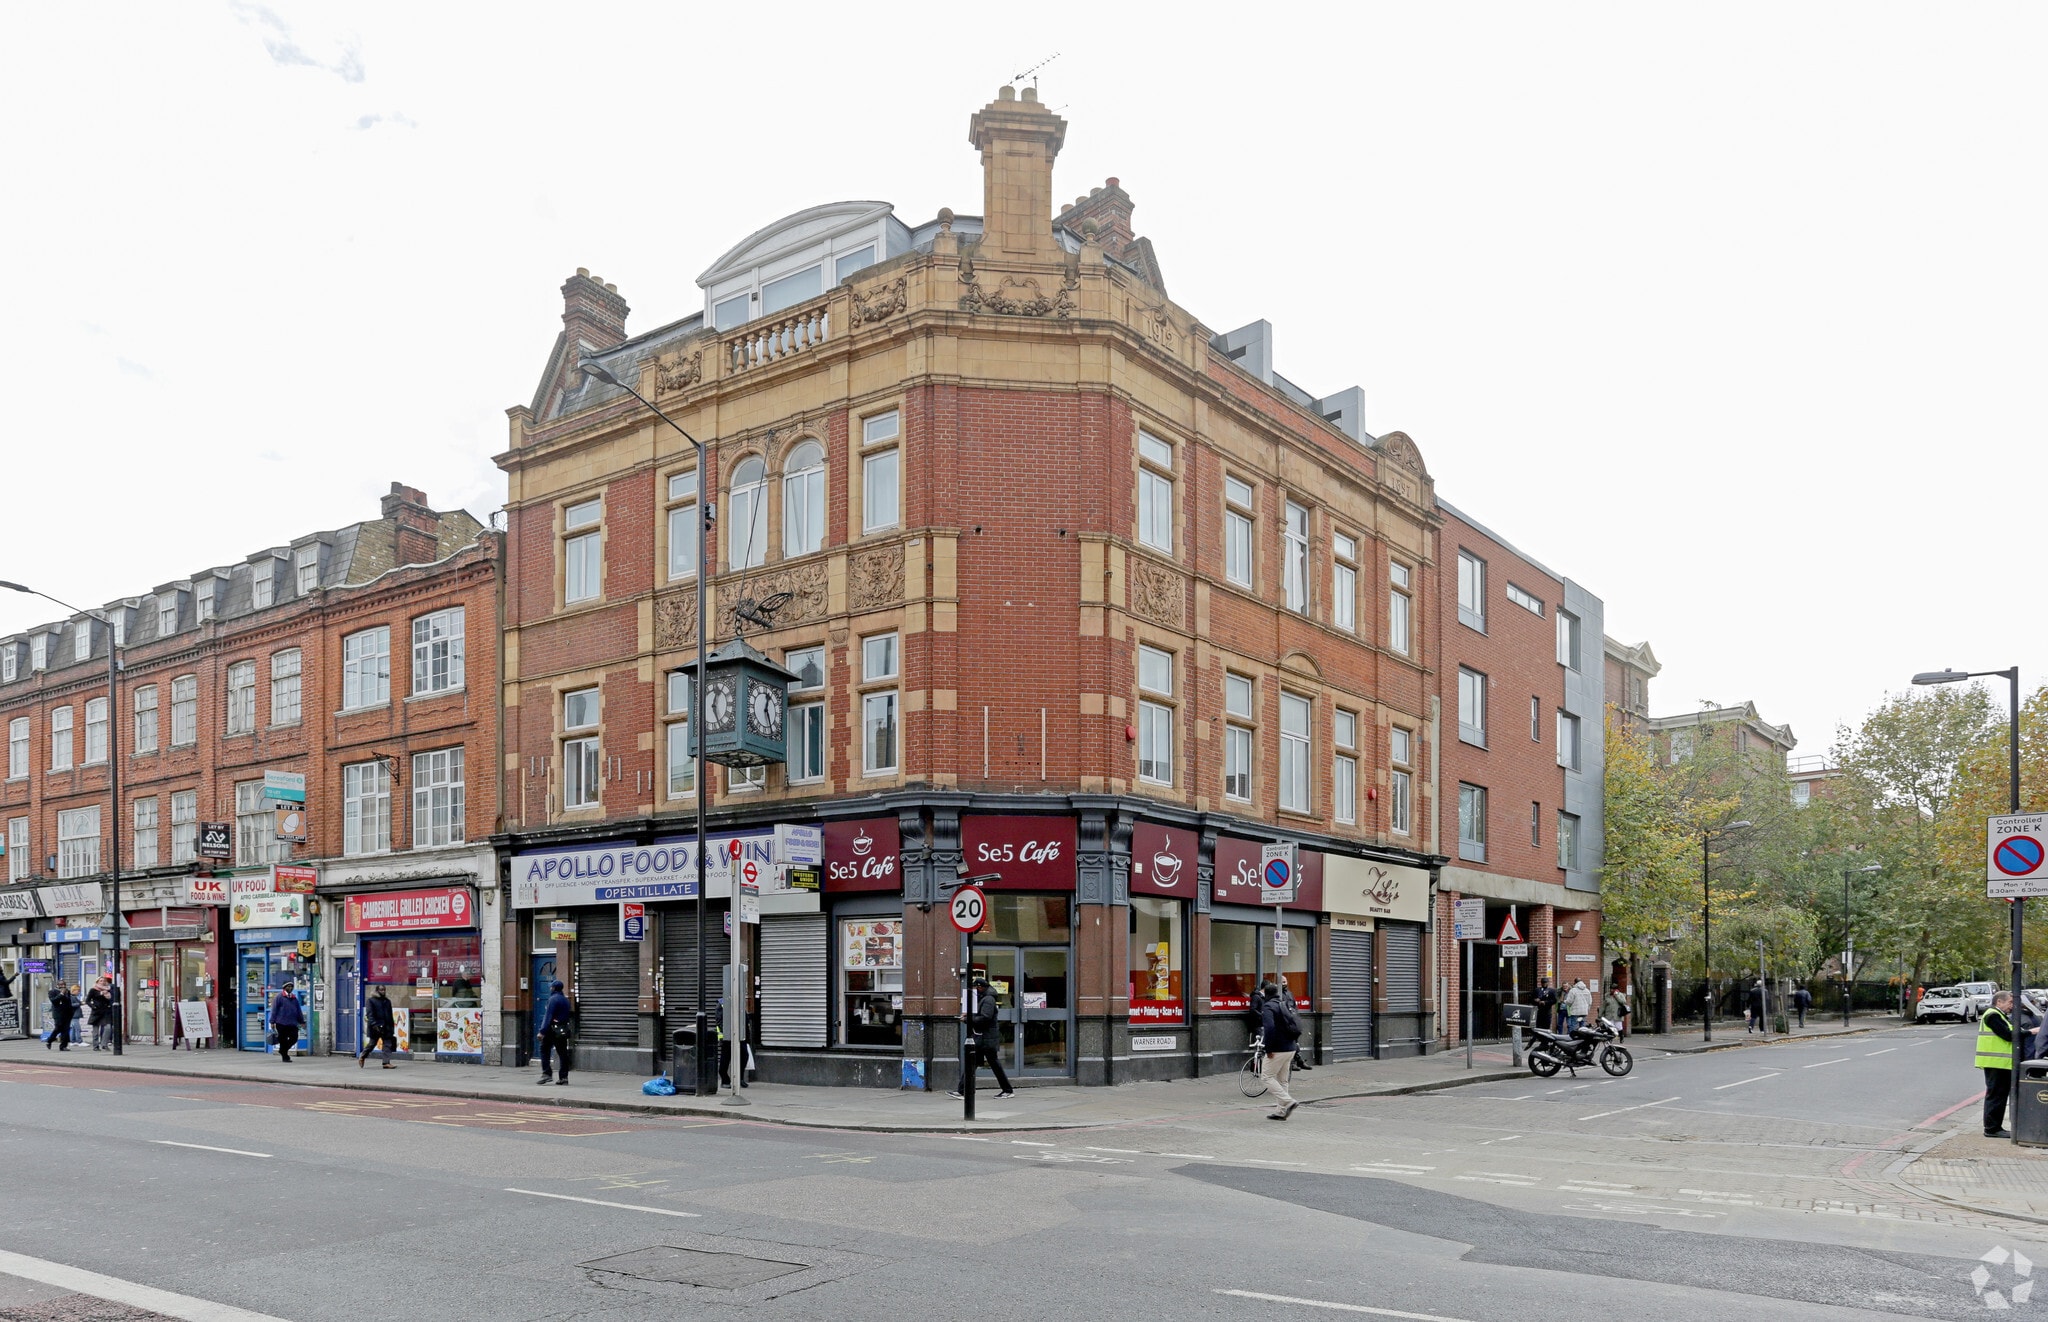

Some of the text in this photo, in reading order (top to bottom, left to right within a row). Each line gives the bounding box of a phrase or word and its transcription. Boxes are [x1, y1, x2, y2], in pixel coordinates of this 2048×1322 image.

[1148, 320, 1174, 352] 1912
[1996, 817, 2042, 825] Controlled
[1997, 825, 2029, 833] ZONE
[734, 842, 739, 854] J
[978, 840, 1061, 864] Se5 Café
[527, 838, 777, 882] APOLLO FOOD & WIN
[830, 856, 895, 879] Se5 Café
[635, 875, 678, 883] SUPERMARKET
[194, 881, 222, 892] UK
[232, 880, 266, 892] UK FOOD
[604, 884, 692, 899] OPEN TILL LATE
[191, 892, 206, 900] FOOD
[212, 893, 226, 901] WINE
[362, 896, 450, 919] CAMBERWELL GRILLED CHICKEN
[956, 899, 980, 918] 20
[1144, 1006, 1159, 1018] Printing
[1163, 1006, 1172, 1016] Scan
